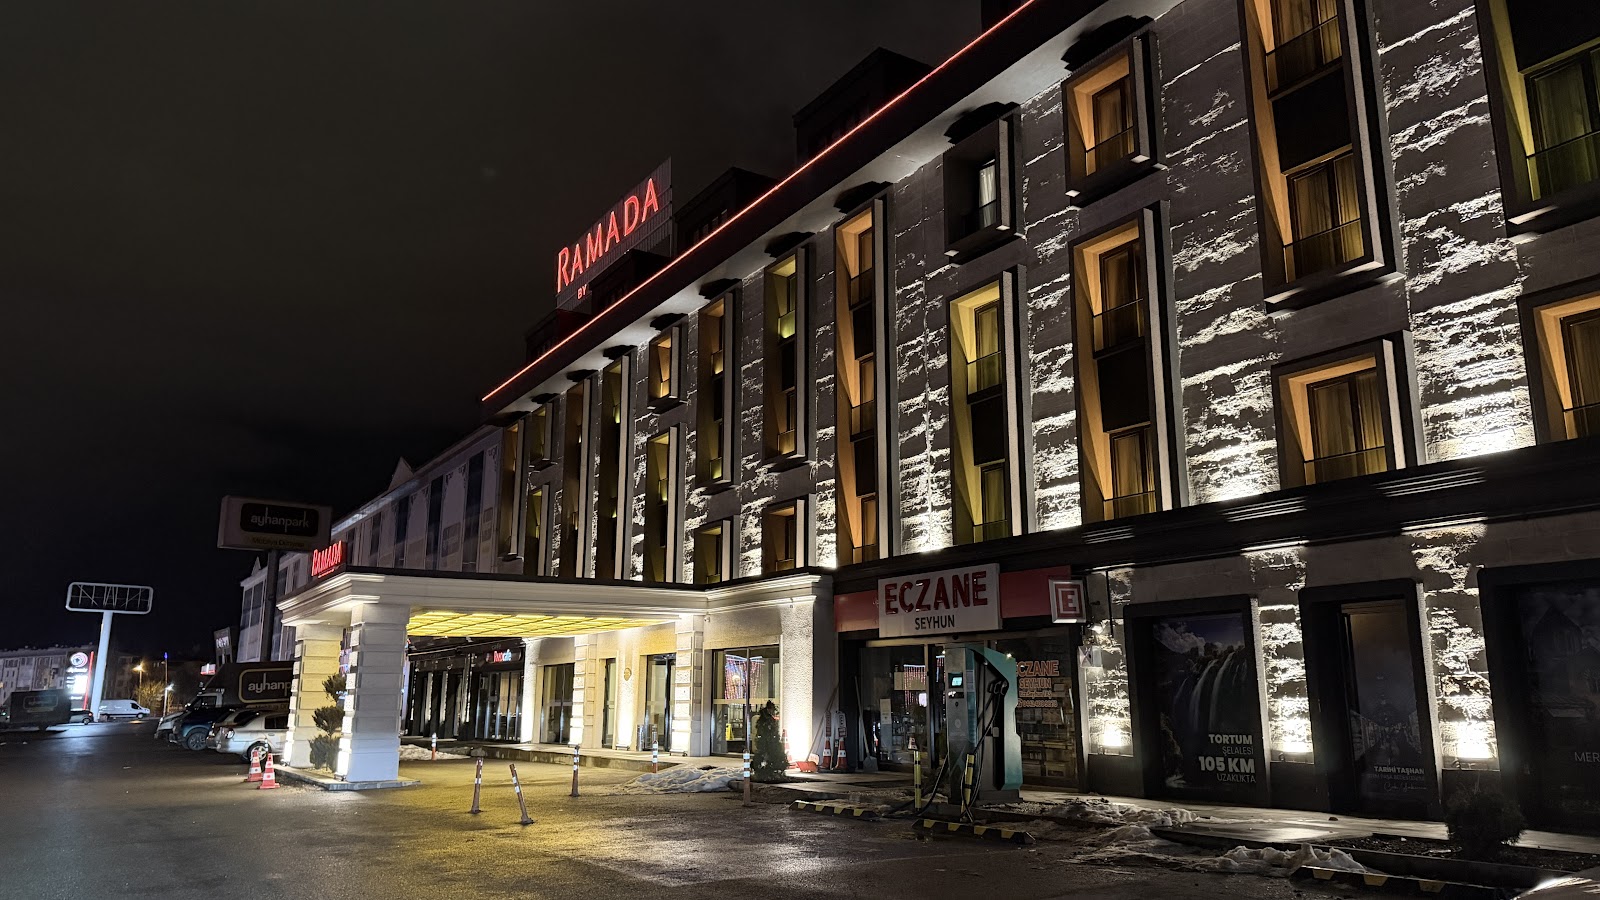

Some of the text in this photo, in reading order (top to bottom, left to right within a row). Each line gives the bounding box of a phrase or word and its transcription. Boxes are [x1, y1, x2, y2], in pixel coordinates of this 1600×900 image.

[557, 177, 659, 293] RAMADA
[577, 284, 588, 300] BY
[250, 506, 310, 533] ayhanpark
[311, 540, 342, 577] RAMADA
[884, 570, 988, 615] ECZANE
[914, 614, 955, 630] SEYHUN
[1016, 660, 1060, 677] CZANE
[1019, 678, 1052, 689] SEYHUN
[1208, 733, 1253, 745] TORTUM
[1222, 745, 1254, 757] ŞELALESİ
[1198, 755, 1256, 774] 105 KM
